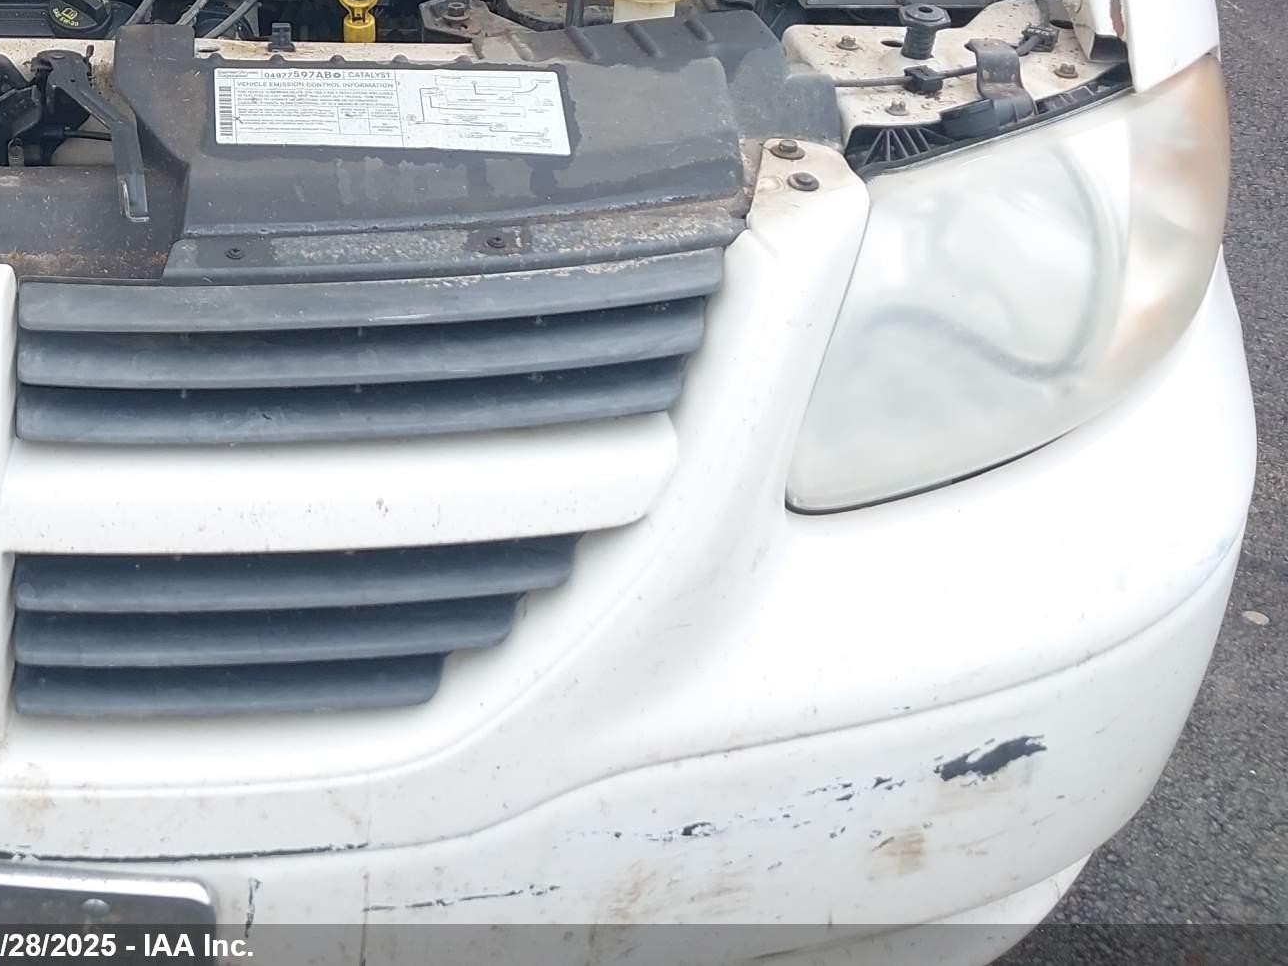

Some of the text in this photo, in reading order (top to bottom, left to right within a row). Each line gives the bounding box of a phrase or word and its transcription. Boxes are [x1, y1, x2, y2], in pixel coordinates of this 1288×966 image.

[347, 70, 391, 79] CATALYST
[268, 80, 305, 88] EMISSION
[342, 81, 394, 89] INFORMATION
